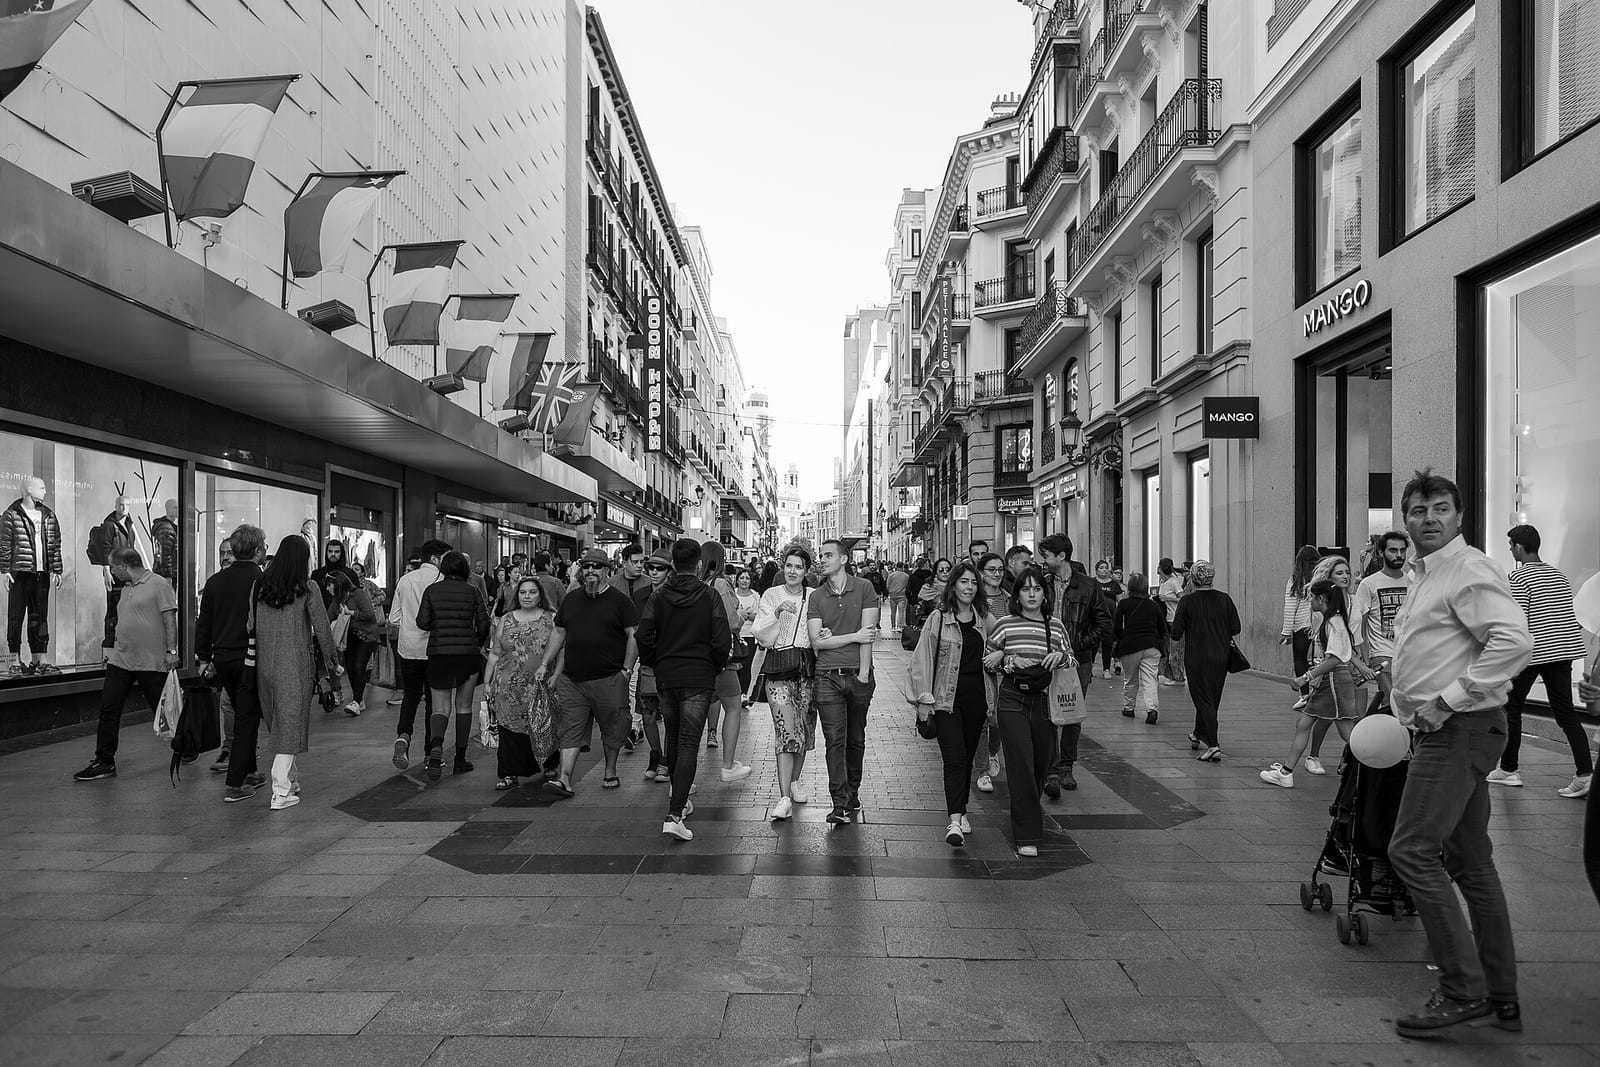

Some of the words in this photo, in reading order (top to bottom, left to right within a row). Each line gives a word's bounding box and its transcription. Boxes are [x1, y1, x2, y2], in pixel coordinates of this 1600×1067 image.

[648, 297, 661, 360] 2000
[1303, 279, 1370, 338] MANGO
[648, 368, 661, 450] SPORT
[1209, 412, 1254, 422] MANGO
[1057, 692, 1077, 704] MUJI
